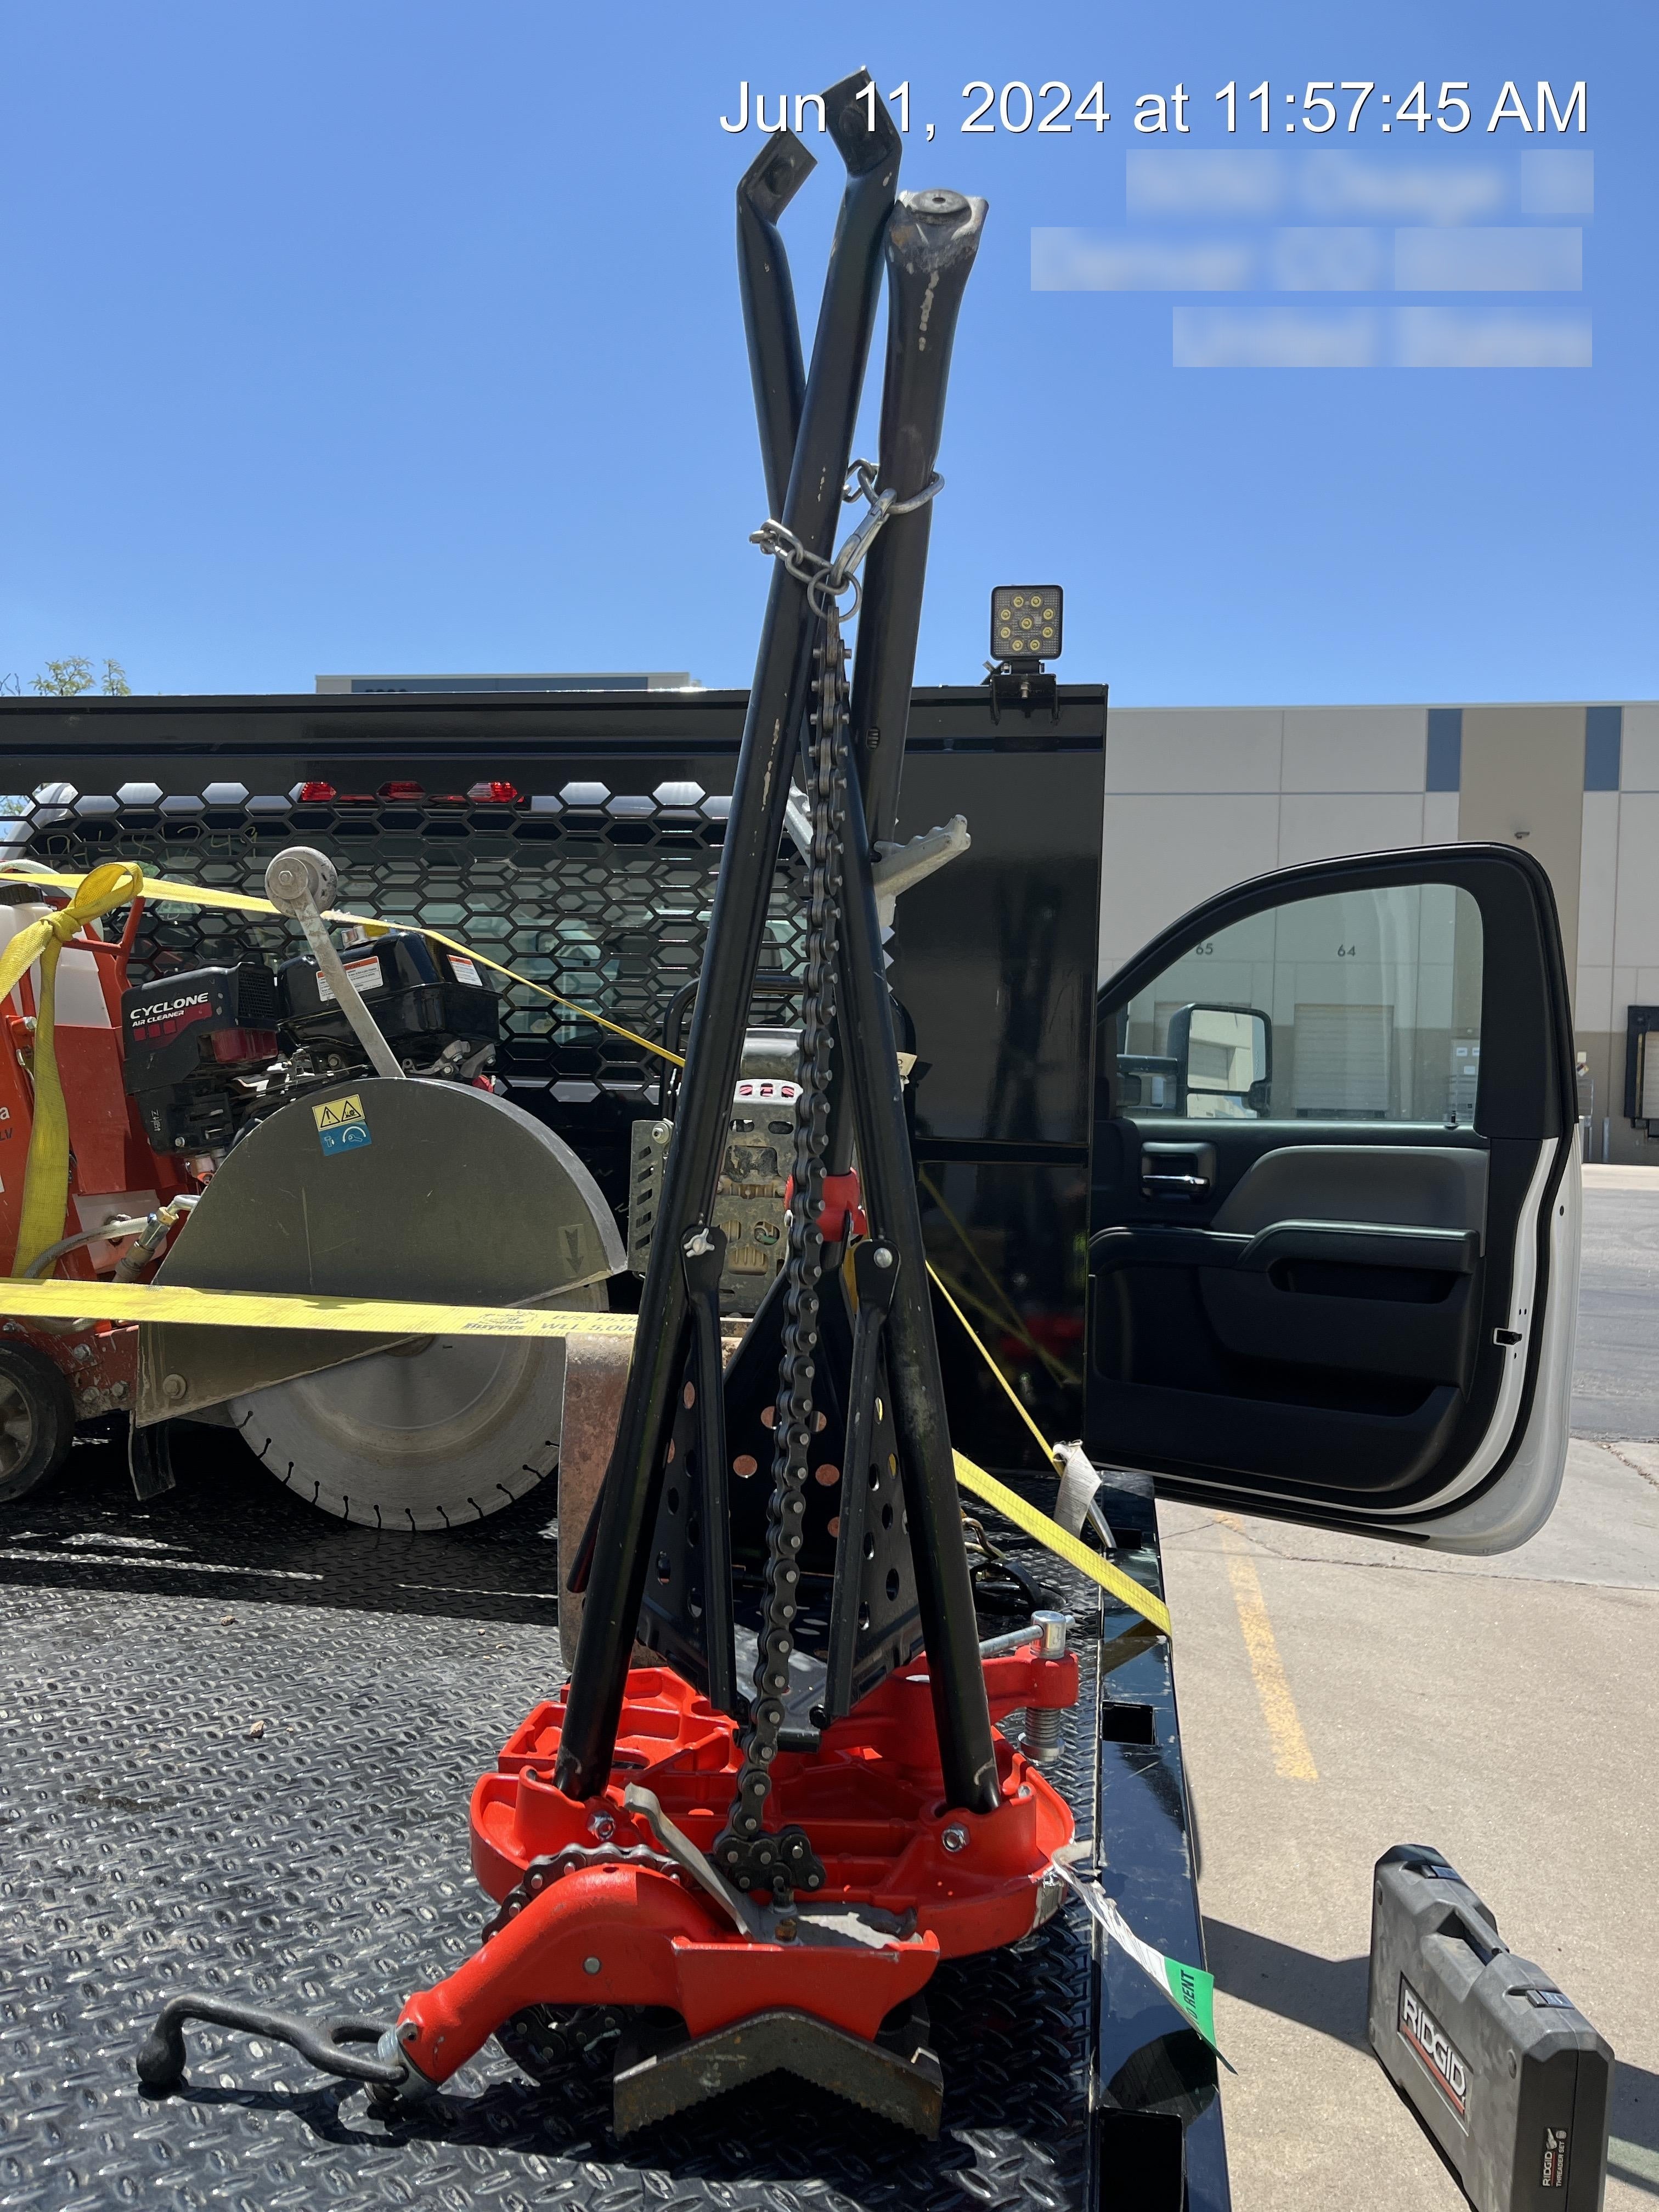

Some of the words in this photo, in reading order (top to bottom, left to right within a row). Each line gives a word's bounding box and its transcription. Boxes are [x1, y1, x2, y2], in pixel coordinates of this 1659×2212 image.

[1195, 943, 1214, 956] 65
[1338, 944, 1356, 957] 64
[130, 992, 209, 1019] CYCLONE
[132, 1019, 146, 1028] AIR
[146, 1010, 184, 1024] CLEANER
[1180, 1968, 1196, 2009] RENT
[1403, 1989, 1466, 2097] RIDGID
[1542, 2151, 1553, 2187] RIDGID
[1556, 2154, 1564, 2187] THREADER
